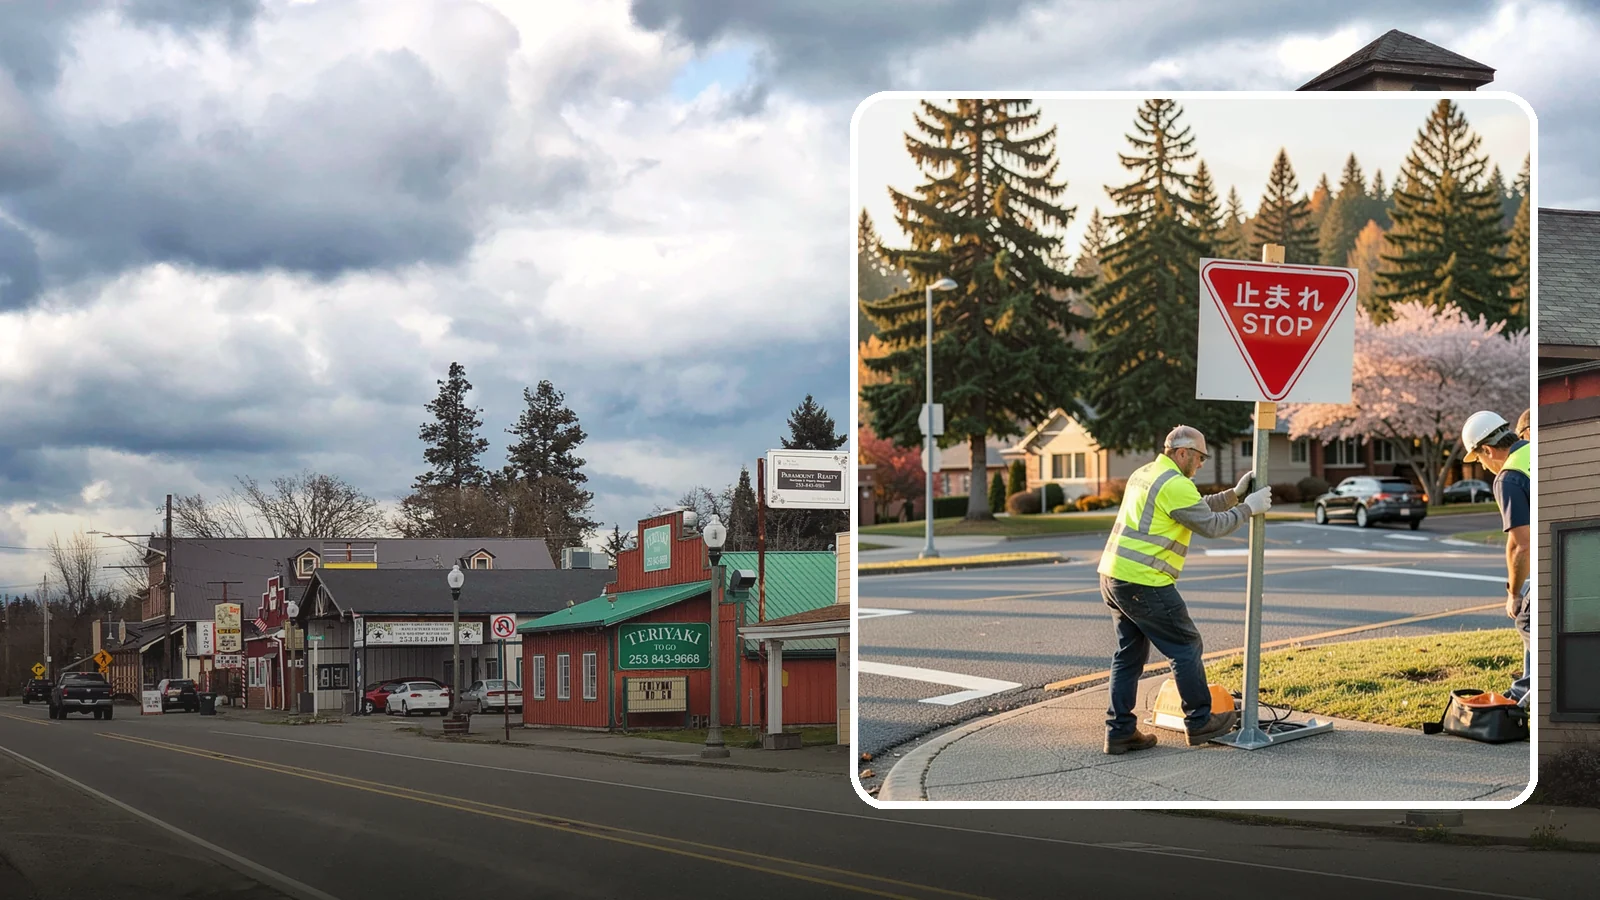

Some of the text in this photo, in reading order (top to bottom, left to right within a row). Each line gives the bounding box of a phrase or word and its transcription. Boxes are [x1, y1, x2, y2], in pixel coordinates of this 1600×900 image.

[1233, 281, 1324, 312] 止まれ
[1242, 312, 1313, 337] STOP
[817, 472, 839, 480] REALTY
[624, 627, 703, 646] TERIYAKI
[653, 643, 677, 651] TO GO
[628, 653, 700, 665] 253 843-9668
[639, 680, 673, 691] TERIYAKI
